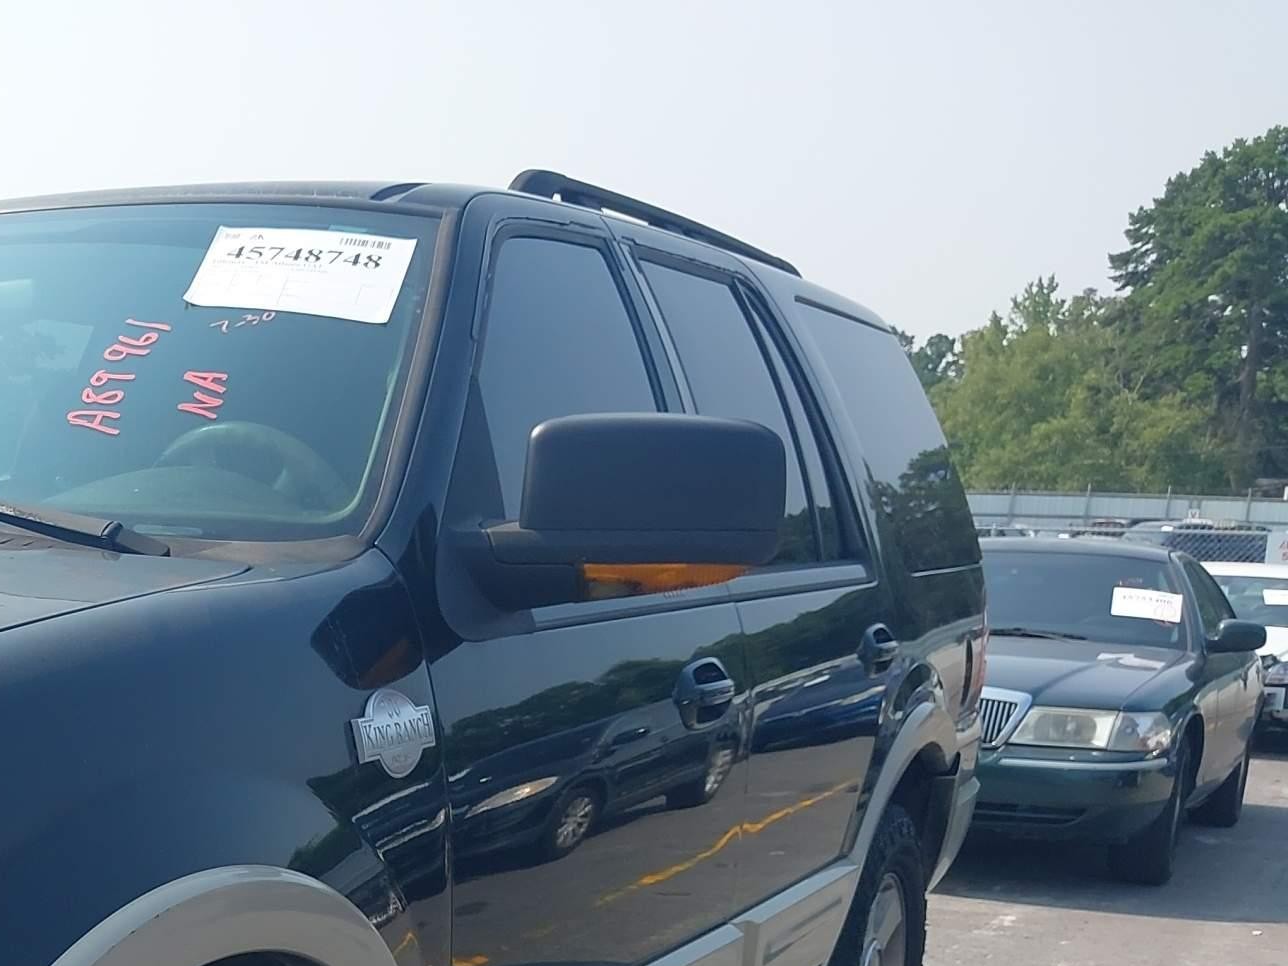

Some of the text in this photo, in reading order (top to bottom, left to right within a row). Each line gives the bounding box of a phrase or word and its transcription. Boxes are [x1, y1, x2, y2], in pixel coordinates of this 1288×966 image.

[226, 244, 384, 270] 45748748
[177, 370, 229, 419] NA
[363, 712, 432, 746] KING RANCH
